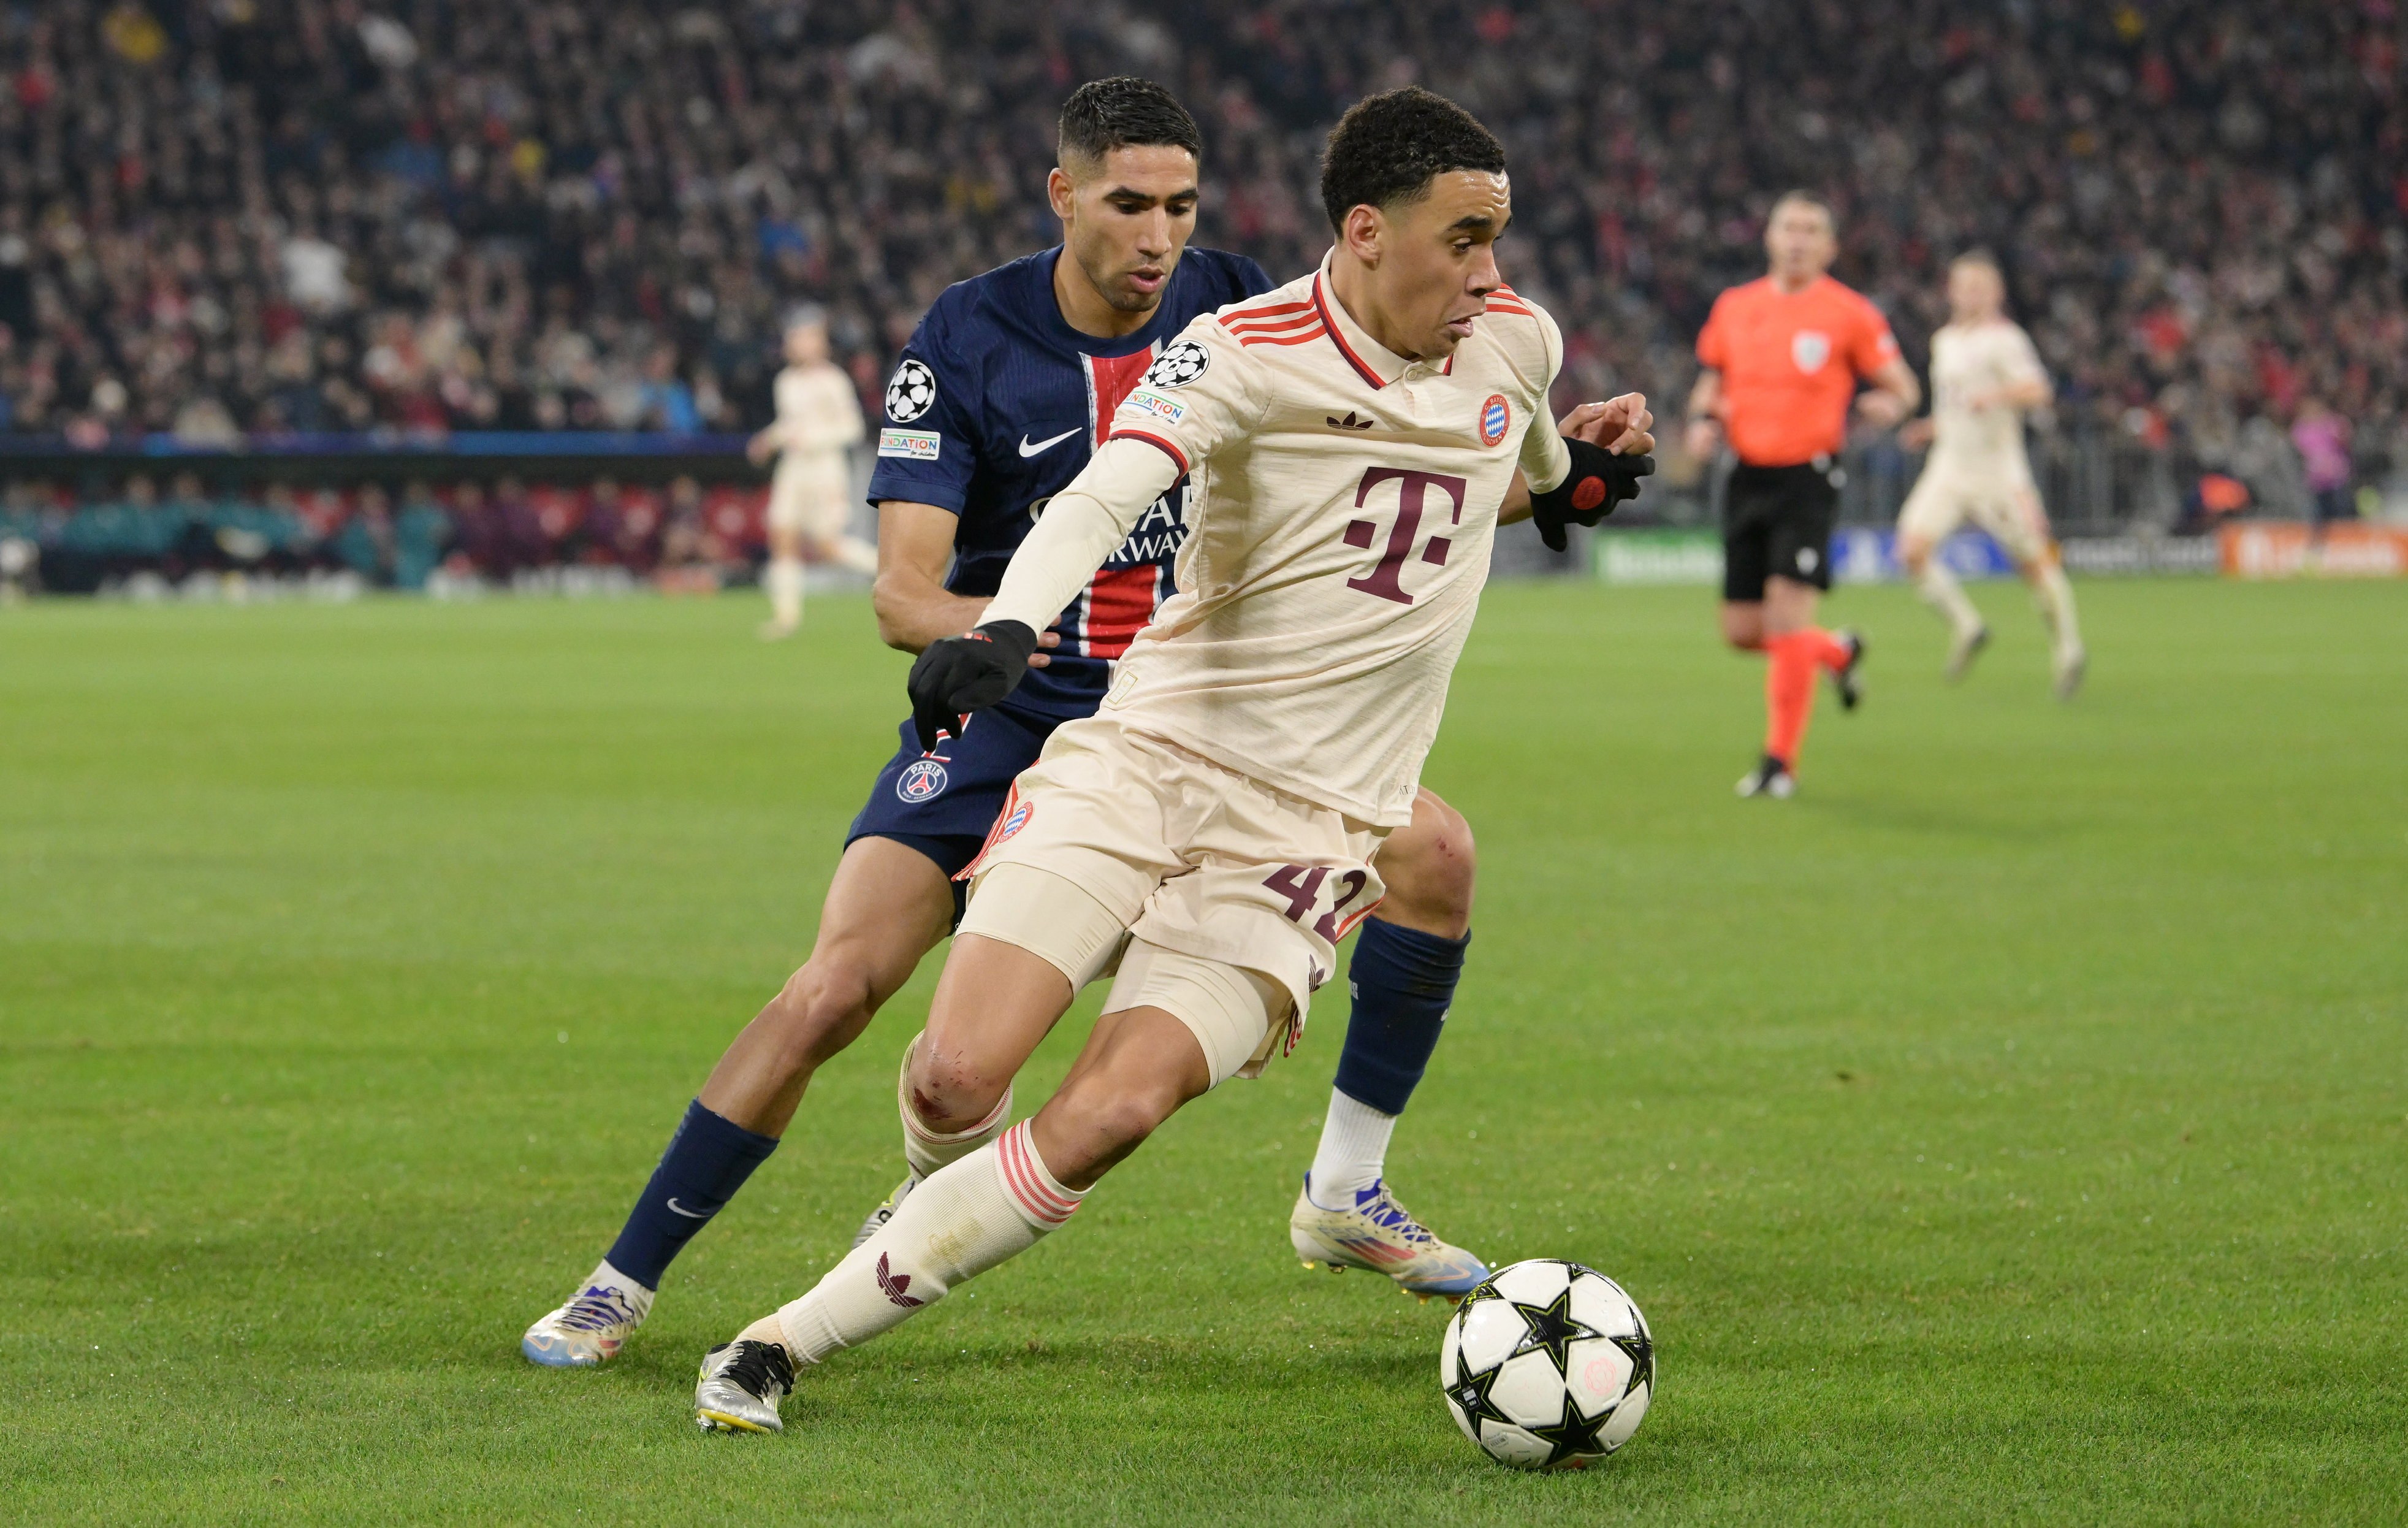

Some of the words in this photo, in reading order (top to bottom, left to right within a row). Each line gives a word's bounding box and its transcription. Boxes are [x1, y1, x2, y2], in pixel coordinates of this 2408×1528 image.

[1344, 467, 1466, 605] T
[910, 763, 942, 777] PARIS
[1262, 864, 1366, 947] 42
